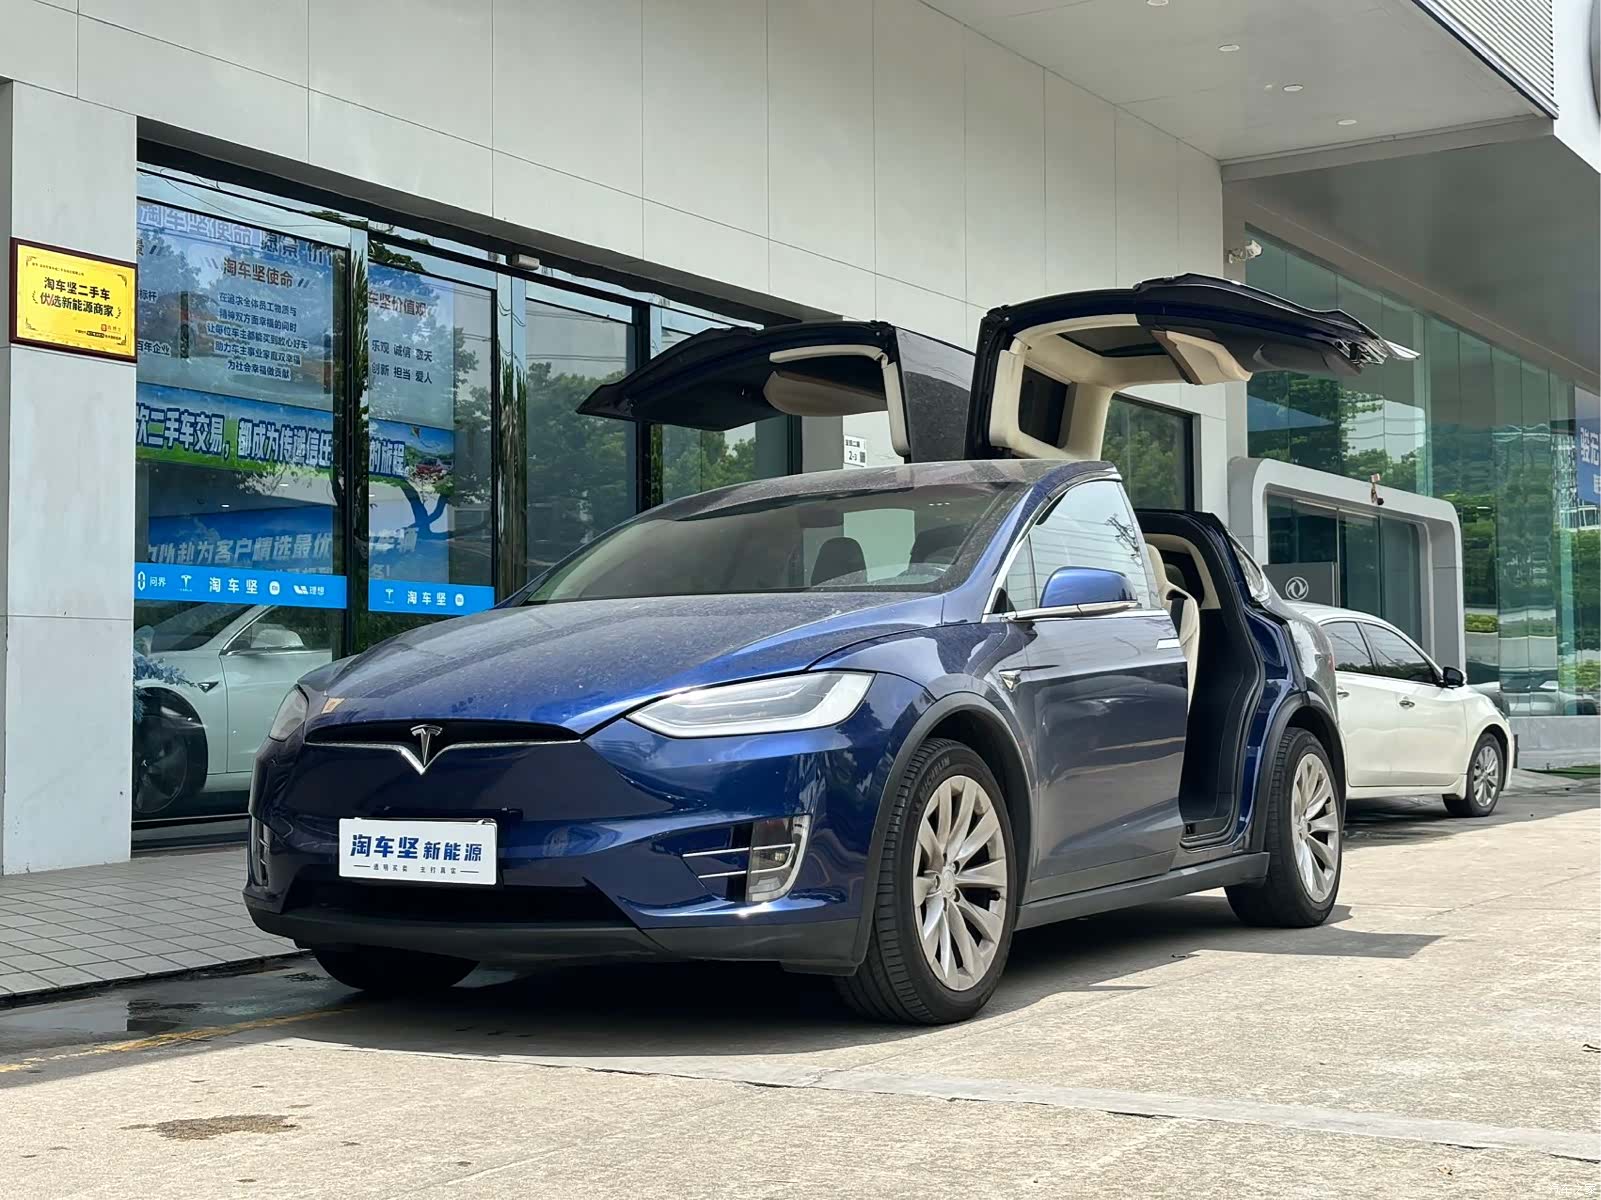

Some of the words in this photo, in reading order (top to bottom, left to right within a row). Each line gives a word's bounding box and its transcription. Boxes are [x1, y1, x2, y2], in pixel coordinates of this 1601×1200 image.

[223, 256, 293, 289] 淘车坚使命
[44, 276, 111, 301] 淘车坚二手车
[40, 292, 114, 318] 优选新能源商家
[219, 291, 297, 317] 在追求全体员工物质与
[368, 289, 427, 317] 车坚价值观
[371, 339, 390, 355] 乐观
[393, 343, 412, 359] 诚信
[228, 359, 290, 380] 为社会幸福做贡献
[371, 361, 390, 377] 创新
[393, 365, 412, 381] 担当
[415, 369, 433, 385] 爱人
[150, 576, 167, 588] 问界
[209, 577, 258, 595] 淘车坚
[407, 590, 447, 606] 淘车坚
[350, 833, 482, 862] 淘车坚新能源
